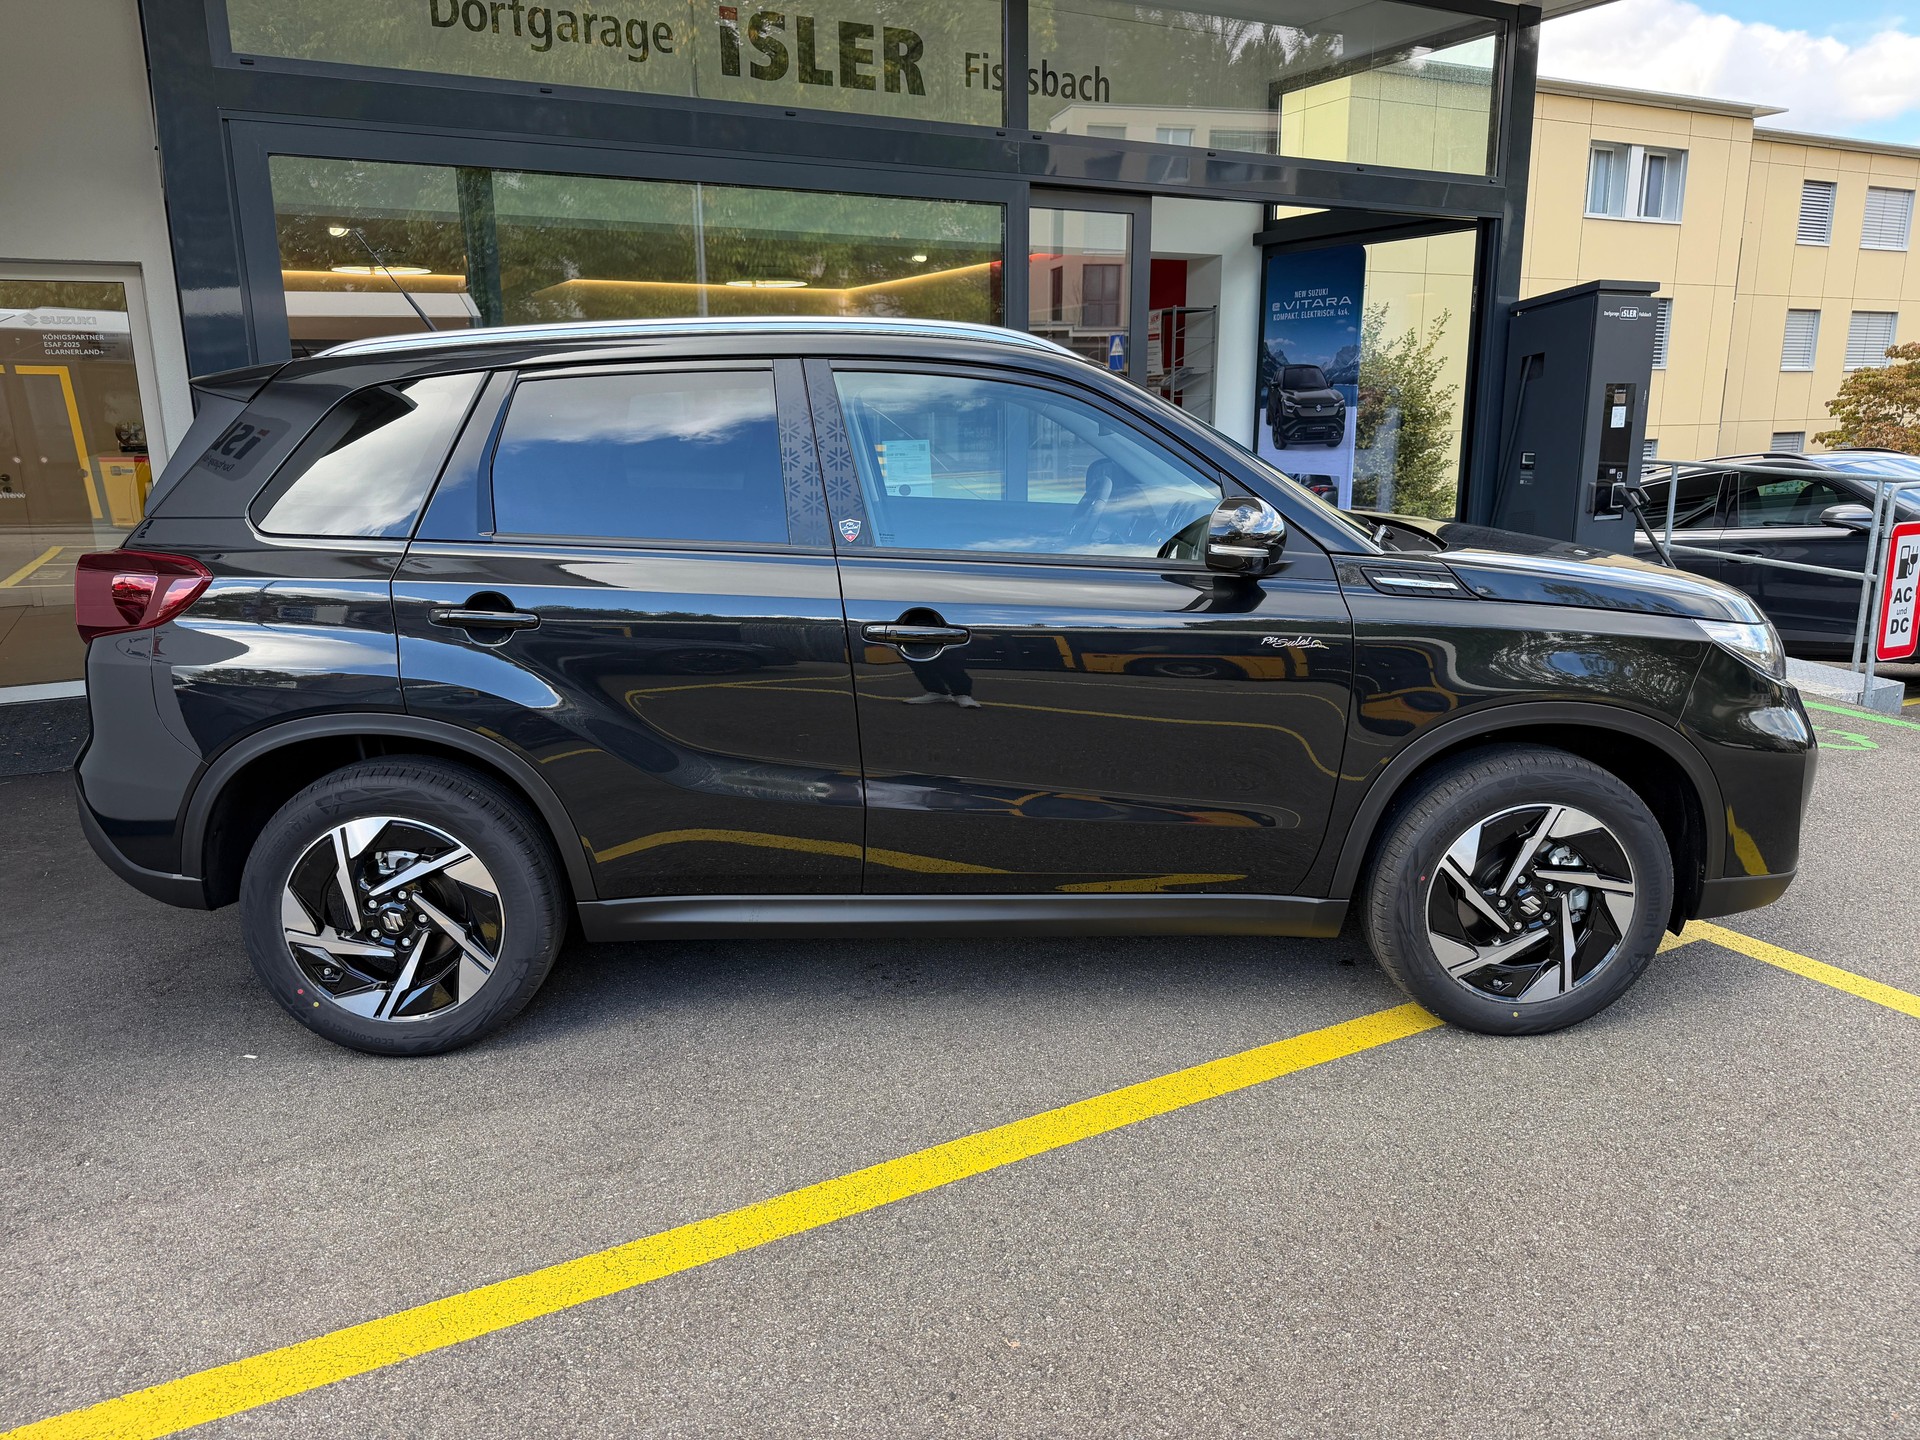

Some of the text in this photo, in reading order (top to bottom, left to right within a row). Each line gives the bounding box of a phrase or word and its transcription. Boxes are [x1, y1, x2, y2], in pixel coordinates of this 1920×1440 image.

[430, 0, 674, 63] Dorfgarage
[965, 52, 1110, 103] Fissbach
[1294, 288, 1329, 299] NEW SUZUKI
[1283, 296, 1352, 310] VITARA
[39, 315, 97, 326] SUZUKI
[1273, 312, 1300, 321] KOMPAKT.
[1300, 309, 1336, 319] ELEKTRISCH.
[42, 333, 105, 342] KÖNIGSPARTNER
[1892, 586, 1913, 604] AC
[1896, 607, 1908, 616] und
[1890, 617, 1910, 635] DC
